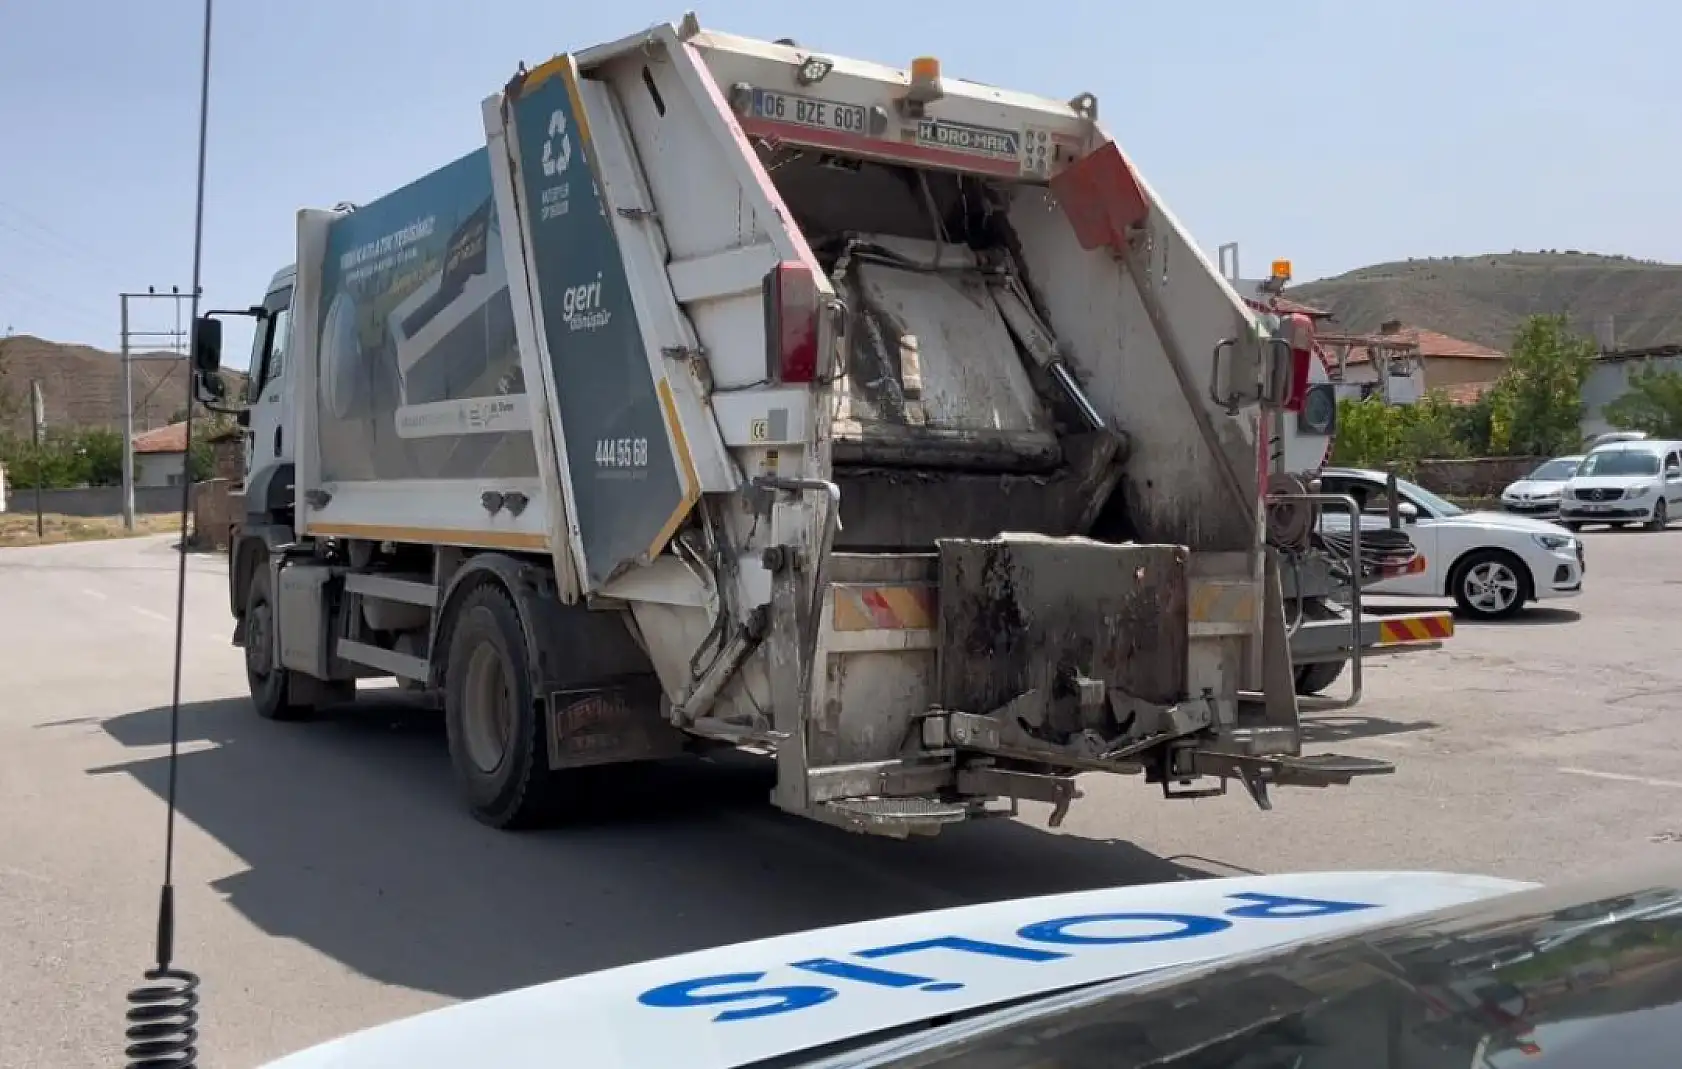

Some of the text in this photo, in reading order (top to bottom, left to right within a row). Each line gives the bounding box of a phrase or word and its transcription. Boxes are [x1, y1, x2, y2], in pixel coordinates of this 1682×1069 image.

[765, 94, 785, 117] 06
[834, 107, 863, 130] 603
[562, 270, 603, 322] geri
[595, 438, 615, 467] 444
[616, 437, 632, 467] 55
